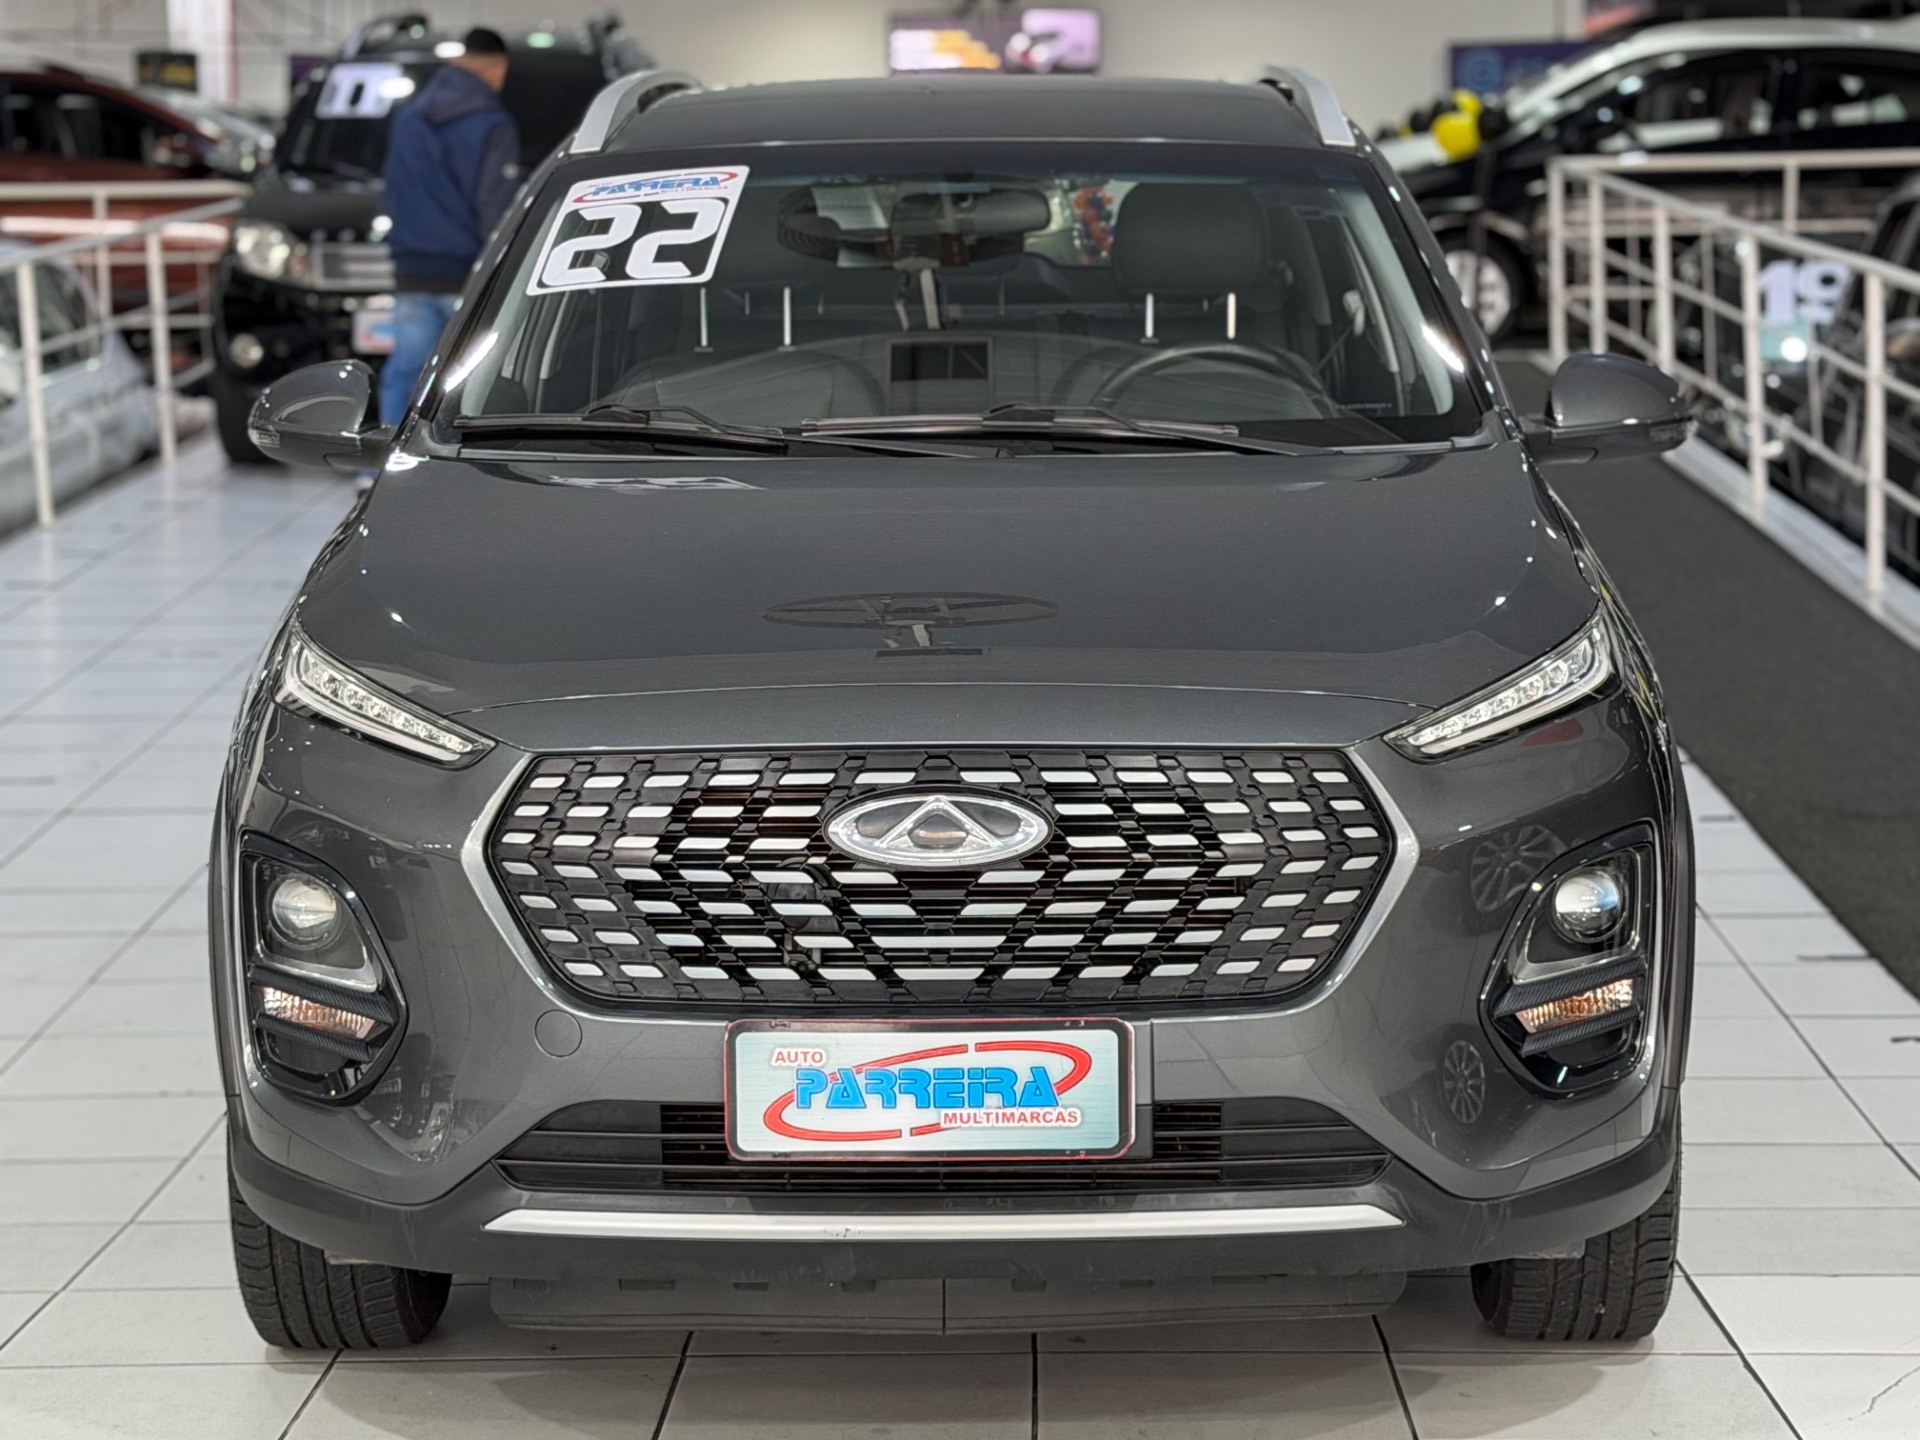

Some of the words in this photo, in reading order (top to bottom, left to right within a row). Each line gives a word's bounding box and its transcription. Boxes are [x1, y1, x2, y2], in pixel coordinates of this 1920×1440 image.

[541, 197, 726, 286] 22
[1757, 258, 1851, 325] 19
[774, 1051, 824, 1063] AUTO
[795, 1066, 1060, 1109] PARREIRA
[943, 1110, 1079, 1125] MULTIMARCAS
